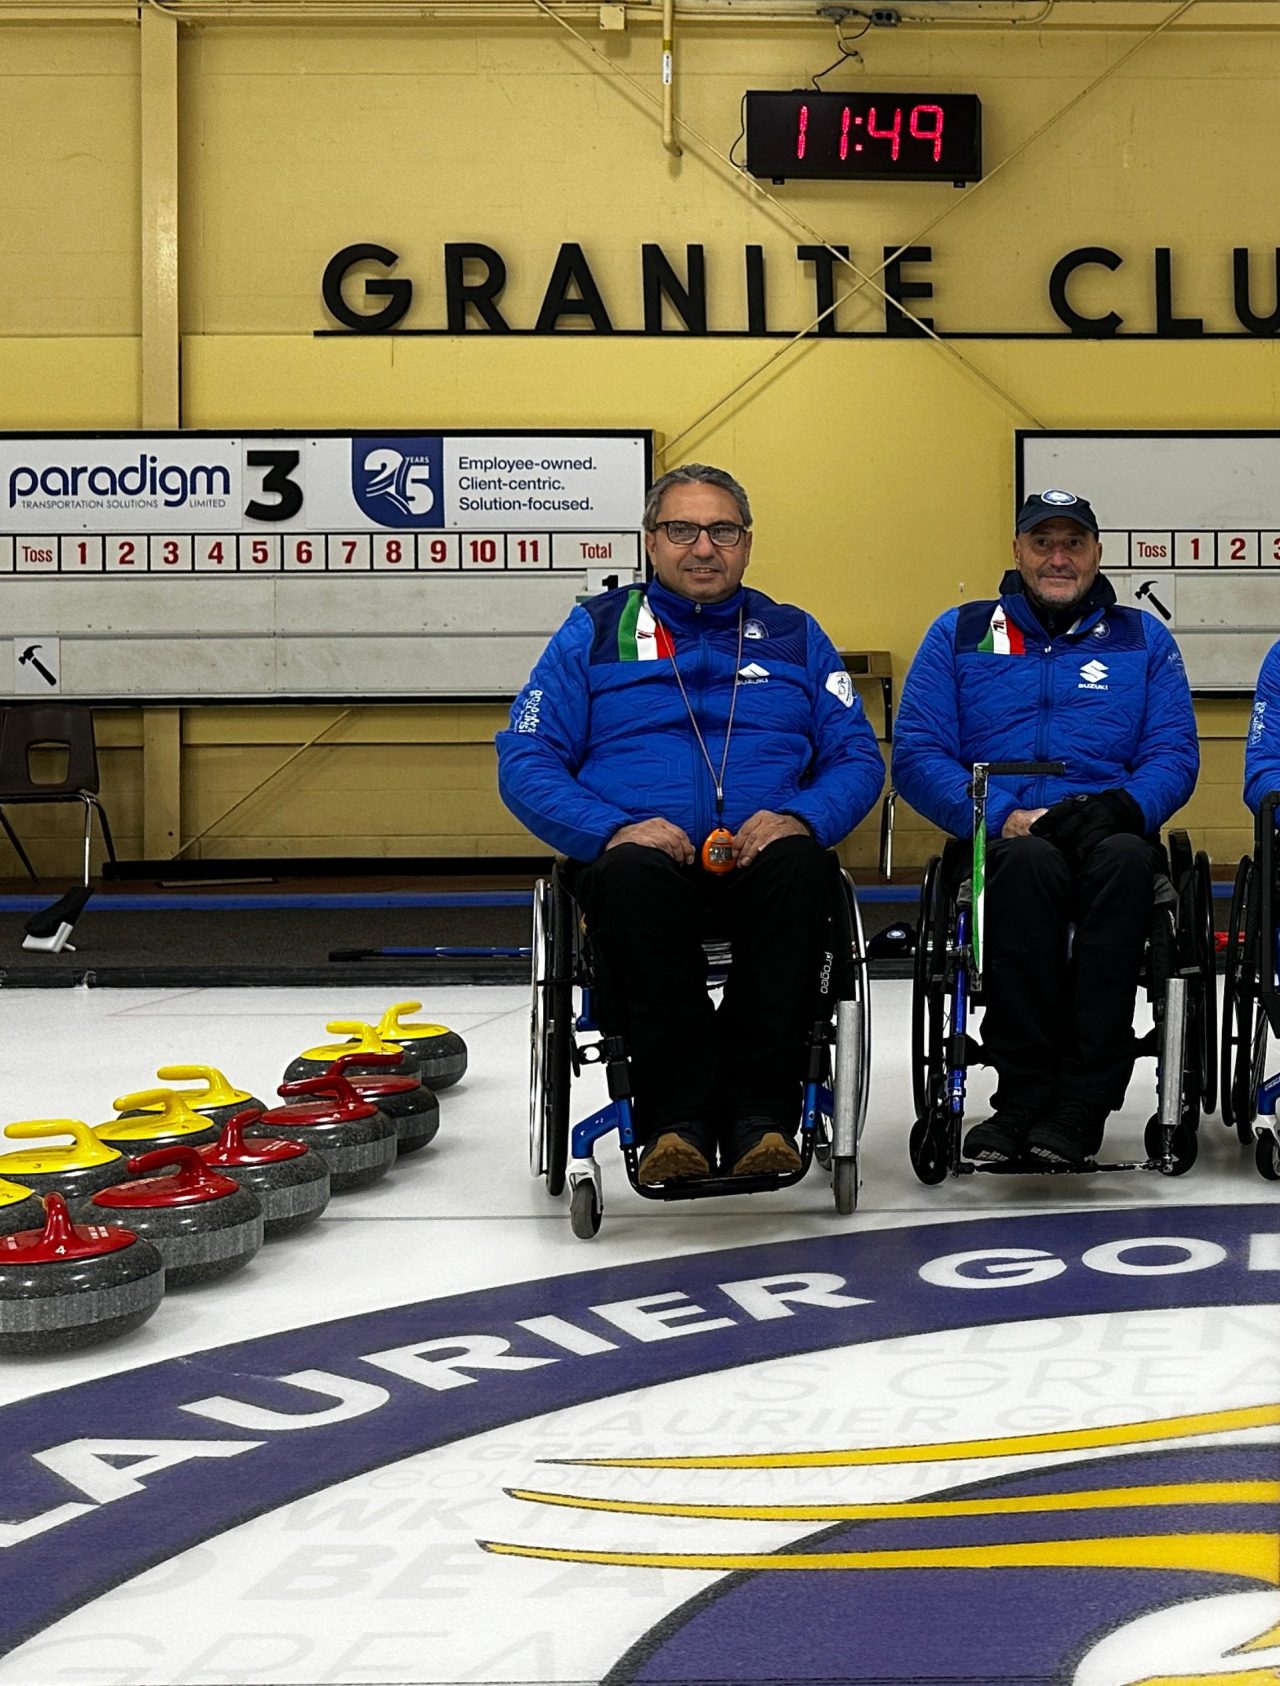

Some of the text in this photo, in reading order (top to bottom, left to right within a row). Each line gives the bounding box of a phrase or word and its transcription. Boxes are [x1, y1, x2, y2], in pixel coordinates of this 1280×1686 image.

[797, 105, 945, 161] 11:49
[322, 243, 935, 332] GRANITE
[458, 456, 597, 472] Employee-owned.
[9, 454, 230, 508] paradigm
[245, 451, 303, 521] 3
[458, 476, 566, 490] Client-centric.
[21, 499, 226, 509] TRANSPORTATION SOLUTIONS LIMITED
[458, 497, 595, 511] Solution-focused.
[21, 540, 612, 564] Toss 1 2 3 4 5 6 7 8 9 10 11 Total
[1137, 542, 1167, 559] Toss
[1190, 538, 1201, 560] 1
[1230, 538, 1247, 561] 2
[1077, 683, 1108, 691] SUZUKI
[218, 1152, 228, 1162] 4
[55, 1244, 66, 1255] 4
[239, 1543, 486, 1600] BE
